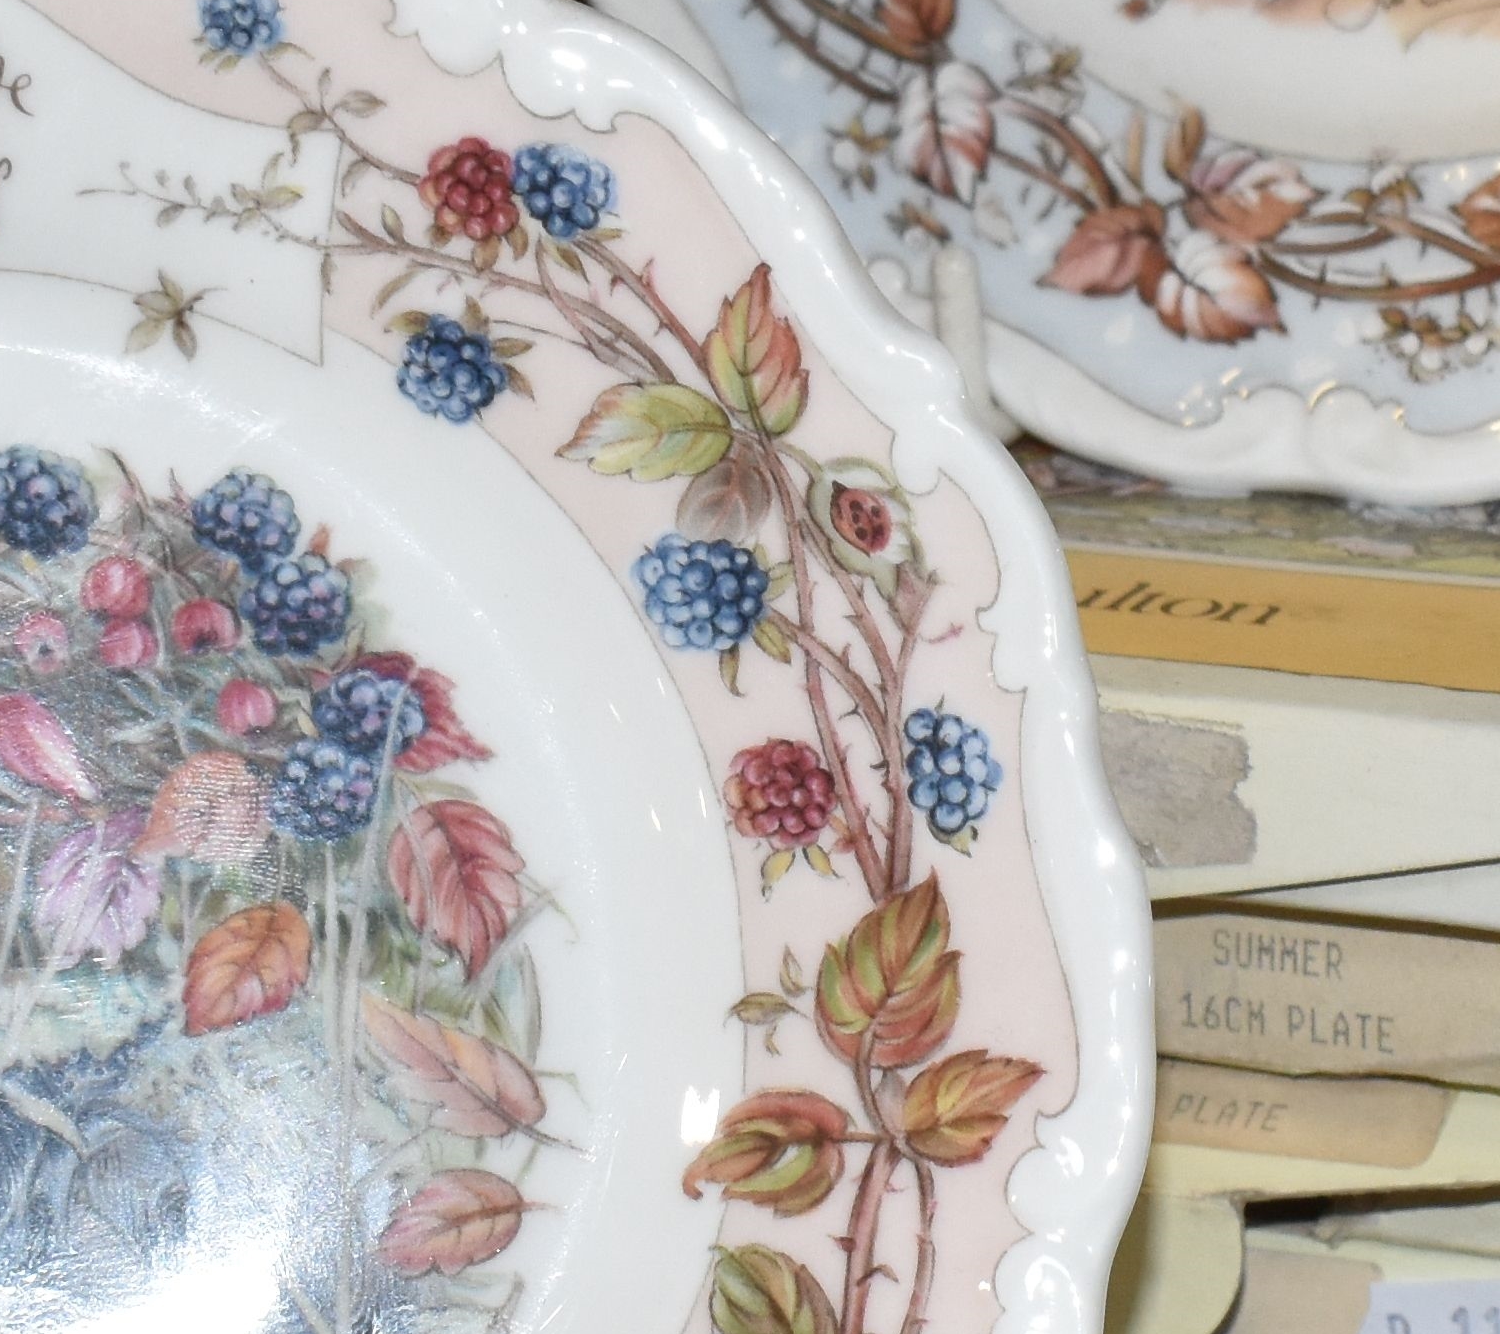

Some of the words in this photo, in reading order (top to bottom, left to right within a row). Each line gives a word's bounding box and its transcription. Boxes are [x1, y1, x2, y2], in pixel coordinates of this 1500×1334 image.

[1211, 927, 1345, 981] SUMMER
[1179, 992, 1267, 1037] 16CM
[1287, 1005, 1395, 1054] PLATE
[1169, 1093, 1289, 1133] PLATE
